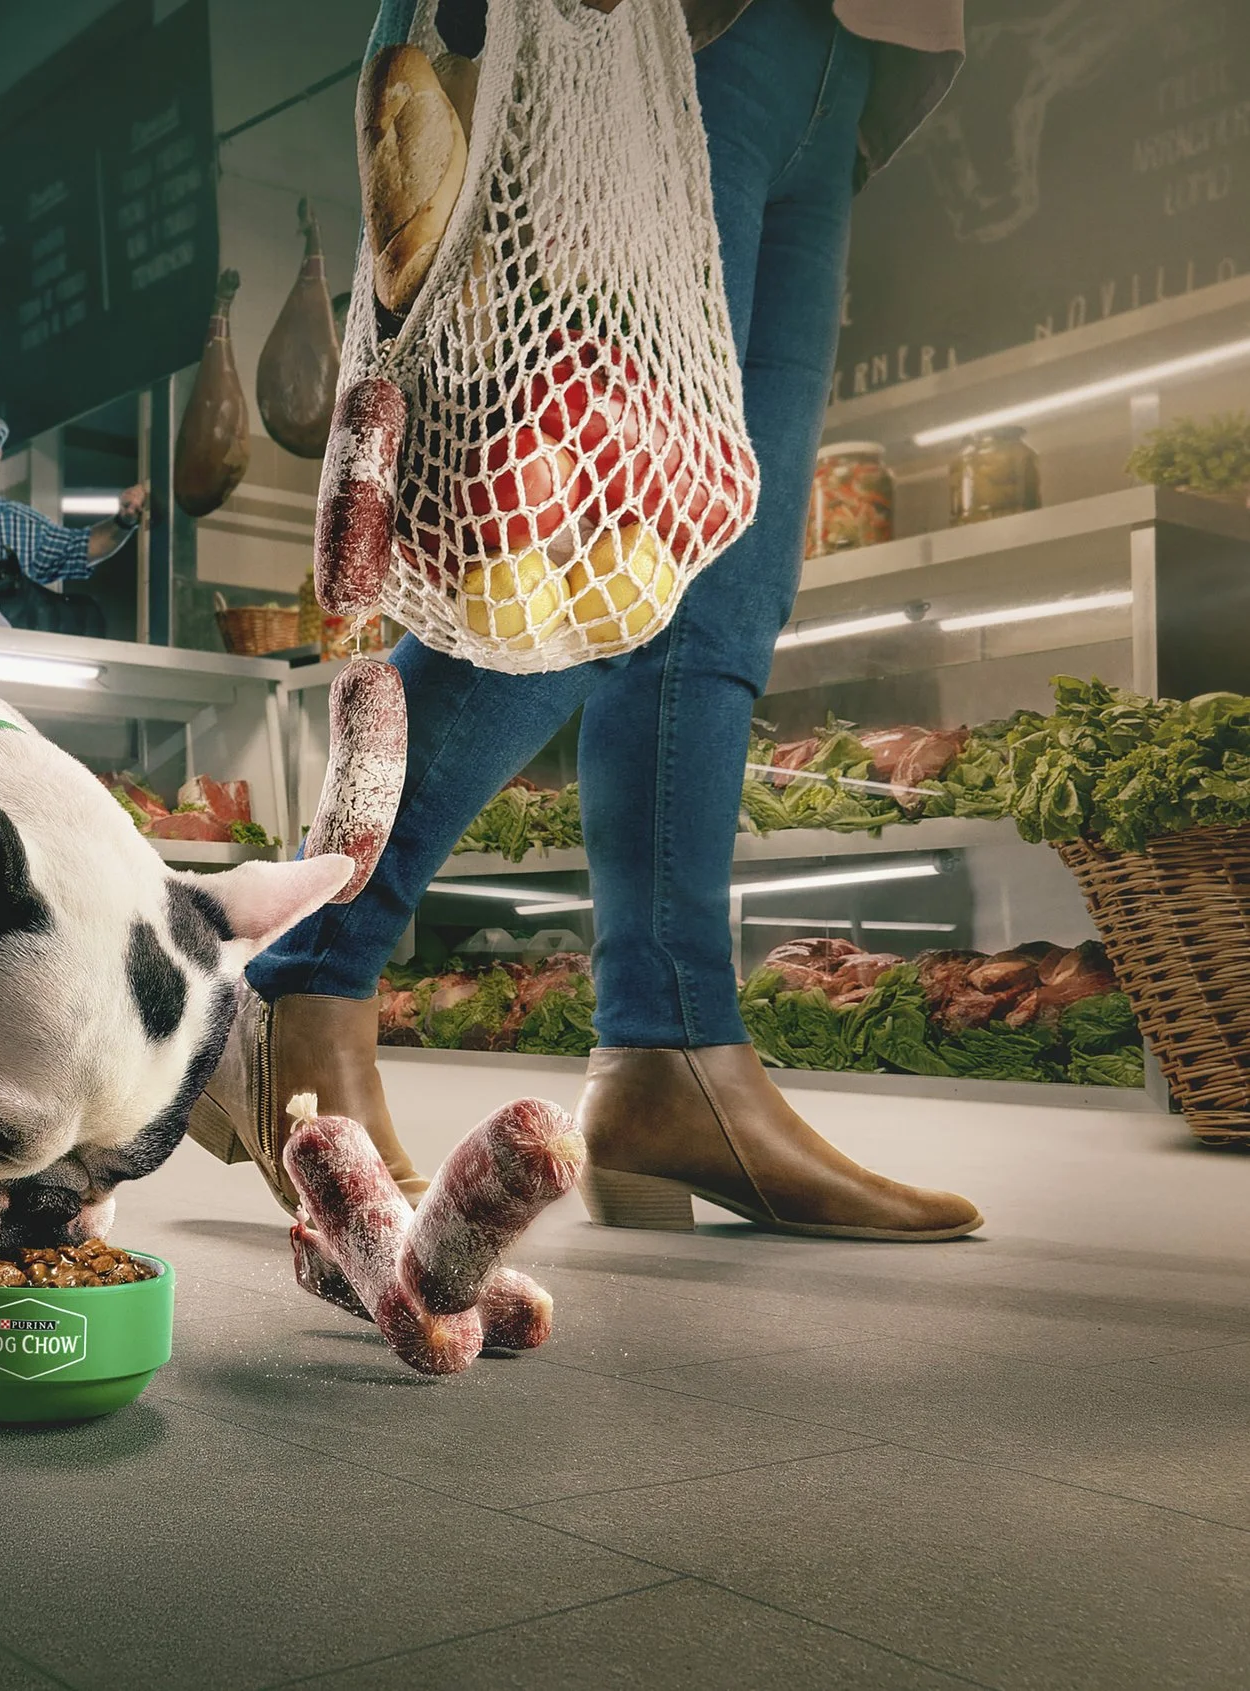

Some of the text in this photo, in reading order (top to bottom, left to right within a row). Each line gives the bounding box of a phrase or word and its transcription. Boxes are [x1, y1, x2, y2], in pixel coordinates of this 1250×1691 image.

[831, 344, 959, 405] ERNERA
[12, 1320, 54, 1330] PURINA
[22, 1334, 78, 1354] CHOW
